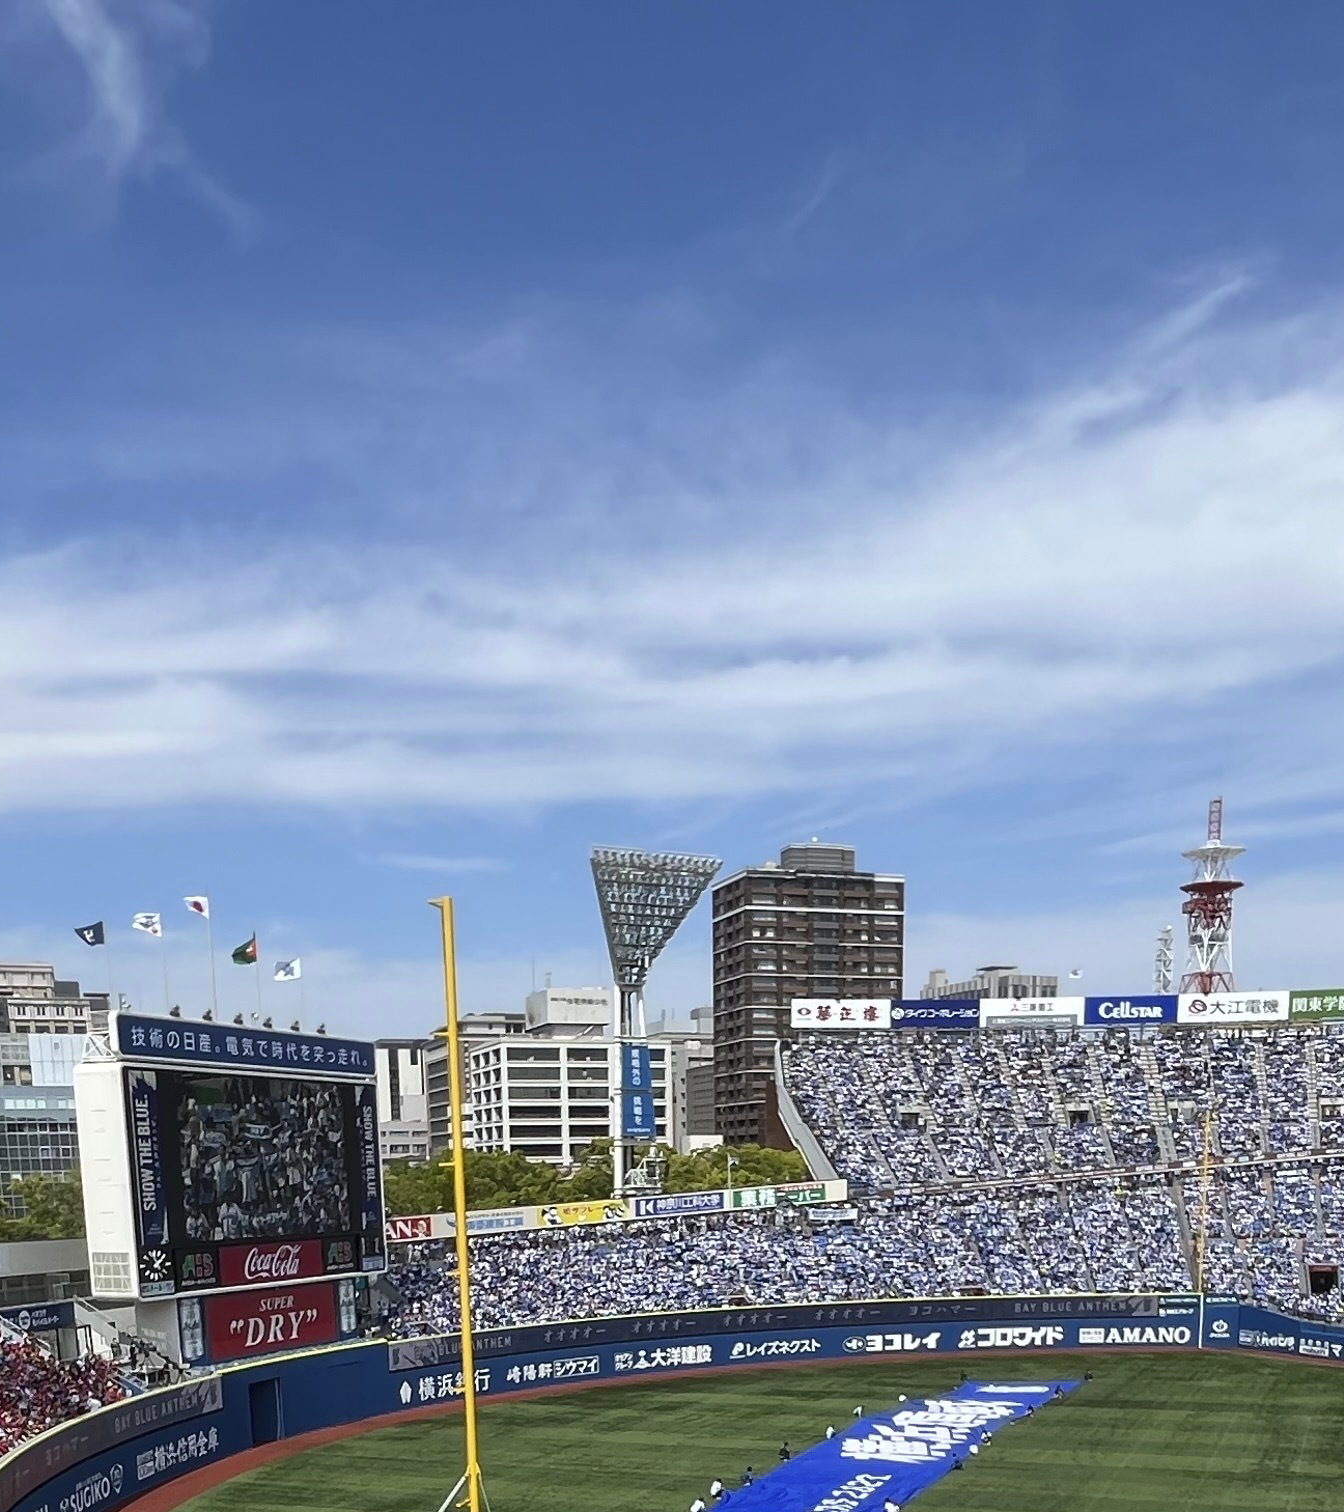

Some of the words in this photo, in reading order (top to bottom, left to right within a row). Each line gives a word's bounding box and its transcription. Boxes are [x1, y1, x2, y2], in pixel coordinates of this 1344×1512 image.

[1210, 999, 1280, 1015] 大江電機
[140, 1165, 157, 1212] SHOW
[258, 1294, 295, 1313] SUPER
[865, 1332, 942, 1352] ヨコレイ
[1105, 1326, 1192, 1345] AMANO
[650, 1345, 713, 1368] 大洋建設
[745, 1338, 822, 1357] レイズネクスト
[506, 1362, 554, 1385] 崎陽軒
[555, 1356, 598, 1377] シウマイ
